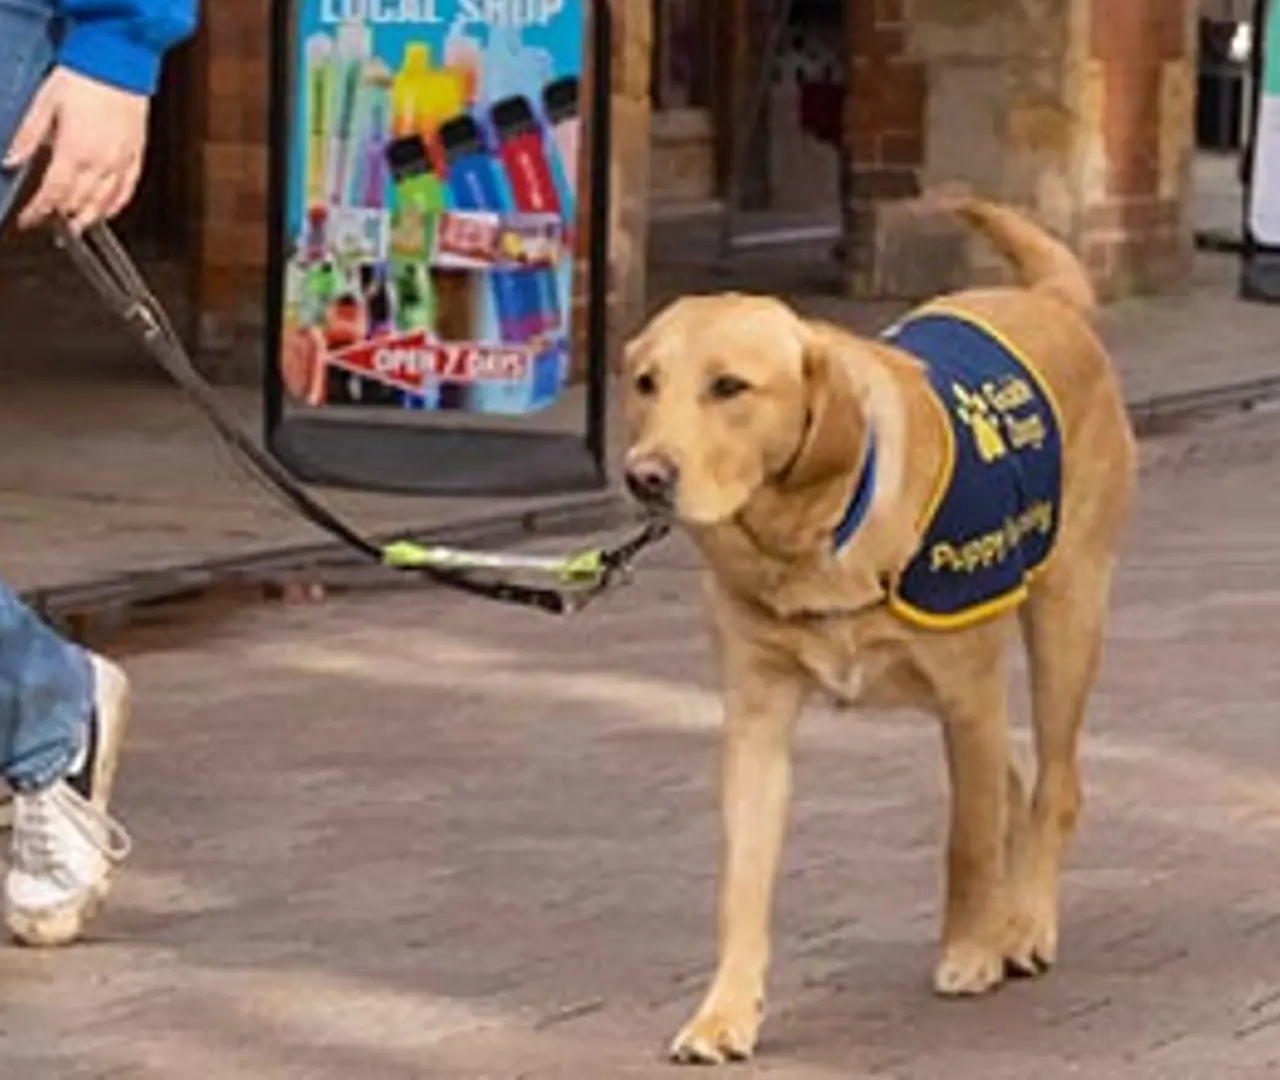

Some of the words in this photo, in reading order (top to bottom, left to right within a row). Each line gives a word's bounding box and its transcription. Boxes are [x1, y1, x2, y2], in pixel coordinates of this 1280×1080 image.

[373, 348, 435, 376] OPEN
[442, 348, 466, 376] 7
[469, 350, 525, 376] DAYS
